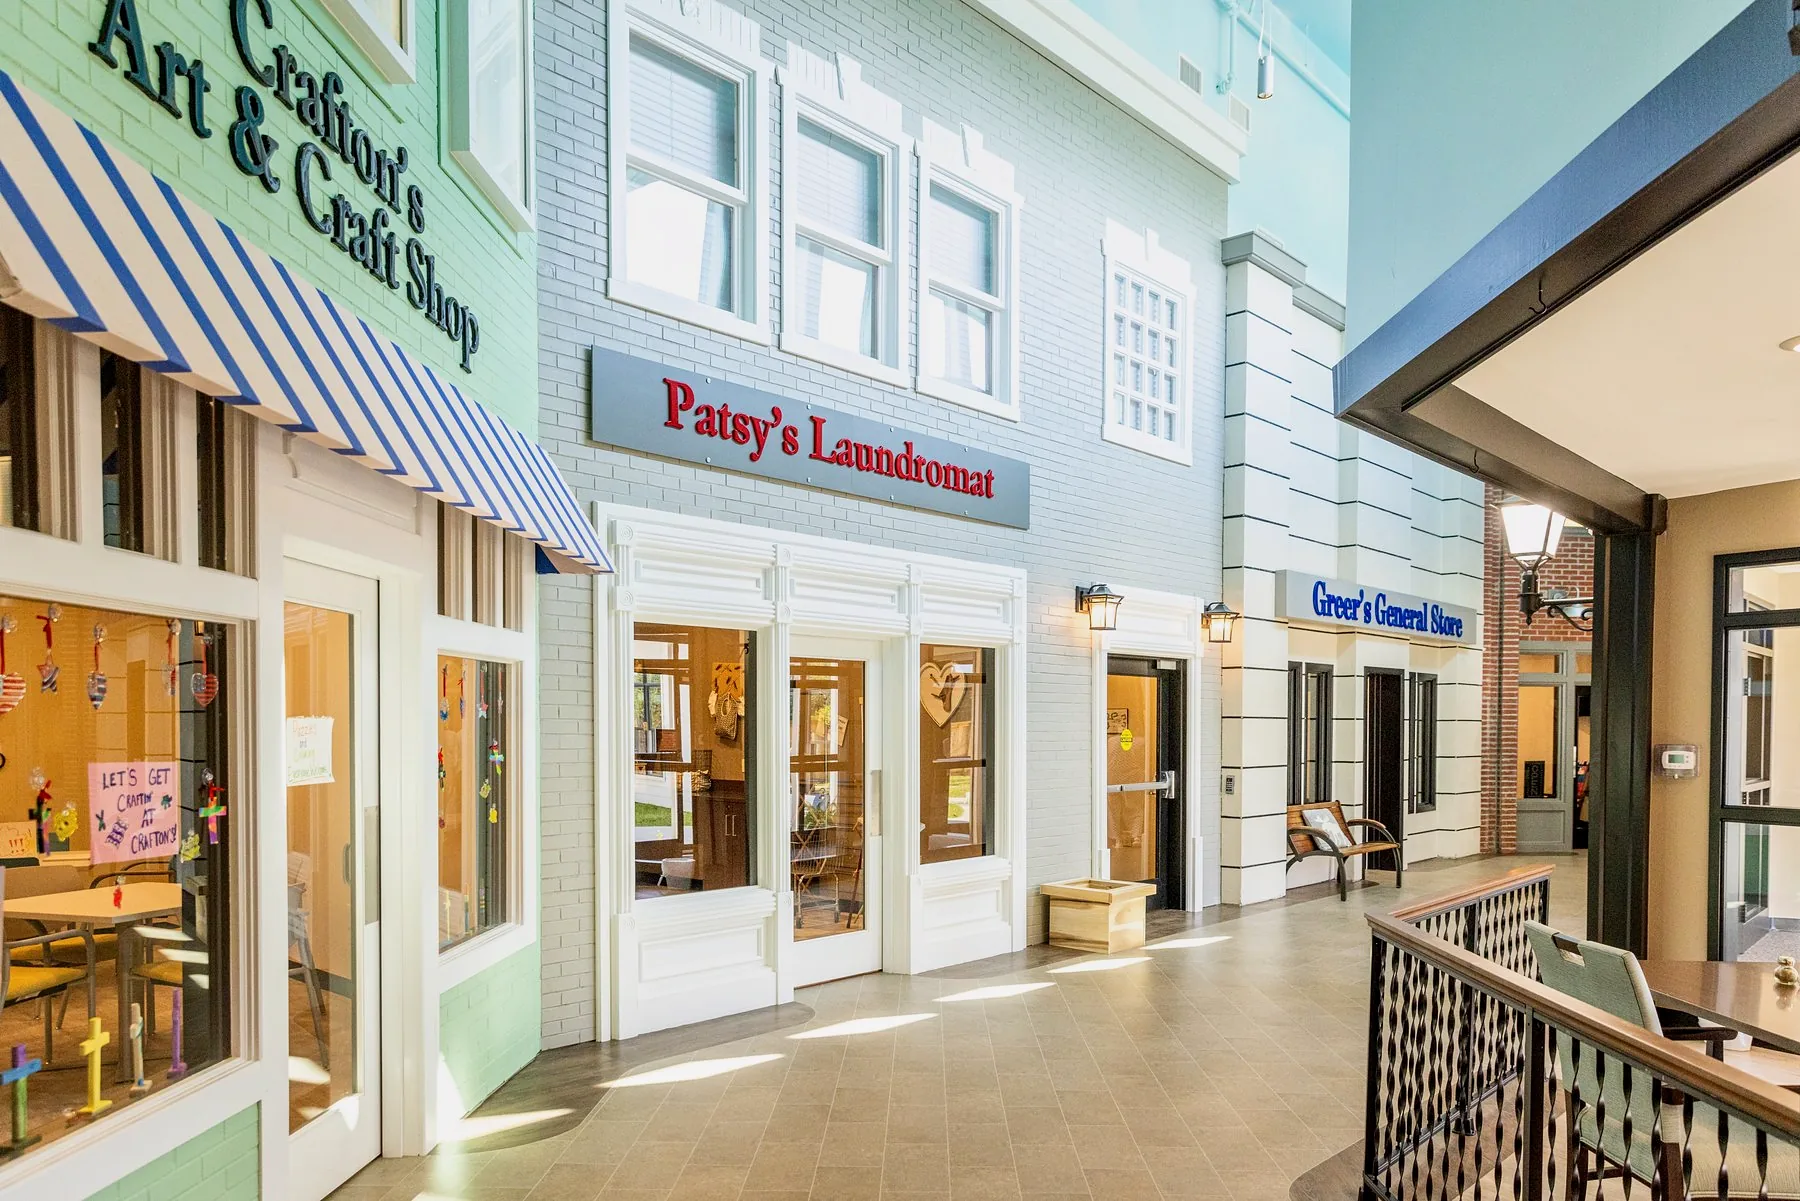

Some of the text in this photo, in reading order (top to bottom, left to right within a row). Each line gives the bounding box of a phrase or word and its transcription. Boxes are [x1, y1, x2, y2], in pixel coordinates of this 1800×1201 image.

[229, 0, 425, 234] Crafton's
[88, 0, 480, 374] Art & Craft Shop
[663, 377, 995, 499] Patsy's Laundromat
[1312, 580, 1463, 638] Greer's General Store
[102, 767, 171, 790] LET'S GET
[141, 808, 156, 828] AT
